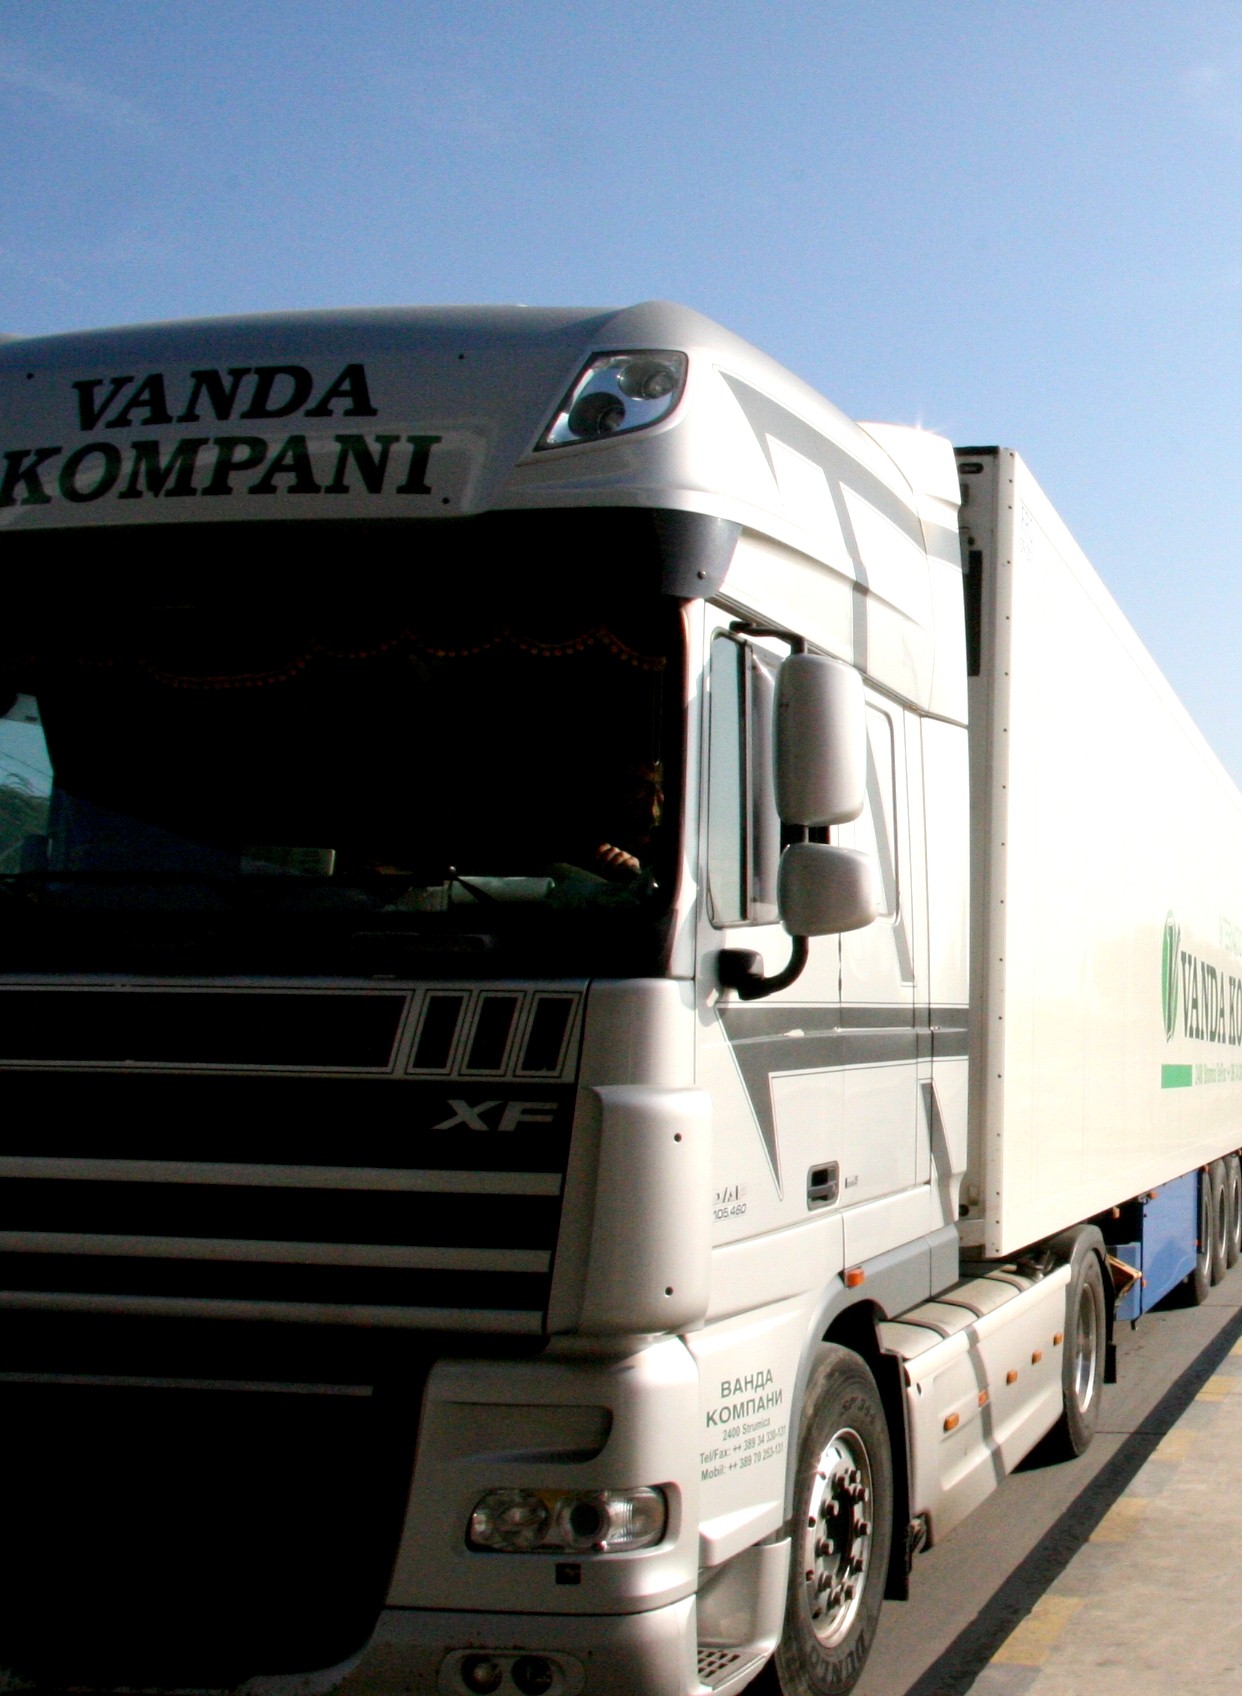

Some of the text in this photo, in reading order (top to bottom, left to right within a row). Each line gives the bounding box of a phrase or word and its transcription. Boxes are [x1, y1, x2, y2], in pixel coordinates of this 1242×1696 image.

[72, 364, 377, 431] VANDA
[0, 434, 442, 507] KOMPANI
[1181, 950, 1226, 1044] VANDA
[430, 1099, 559, 1132] XF
[713, 1203, 747, 1220] 105.460
[721, 1368, 774, 1398] ВАНДА
[706, 1388, 783, 1428] КОМПАНИ
[722, 1417, 771, 1441] 2400 Strumica
[701, 1465, 726, 1481] Mobil:
